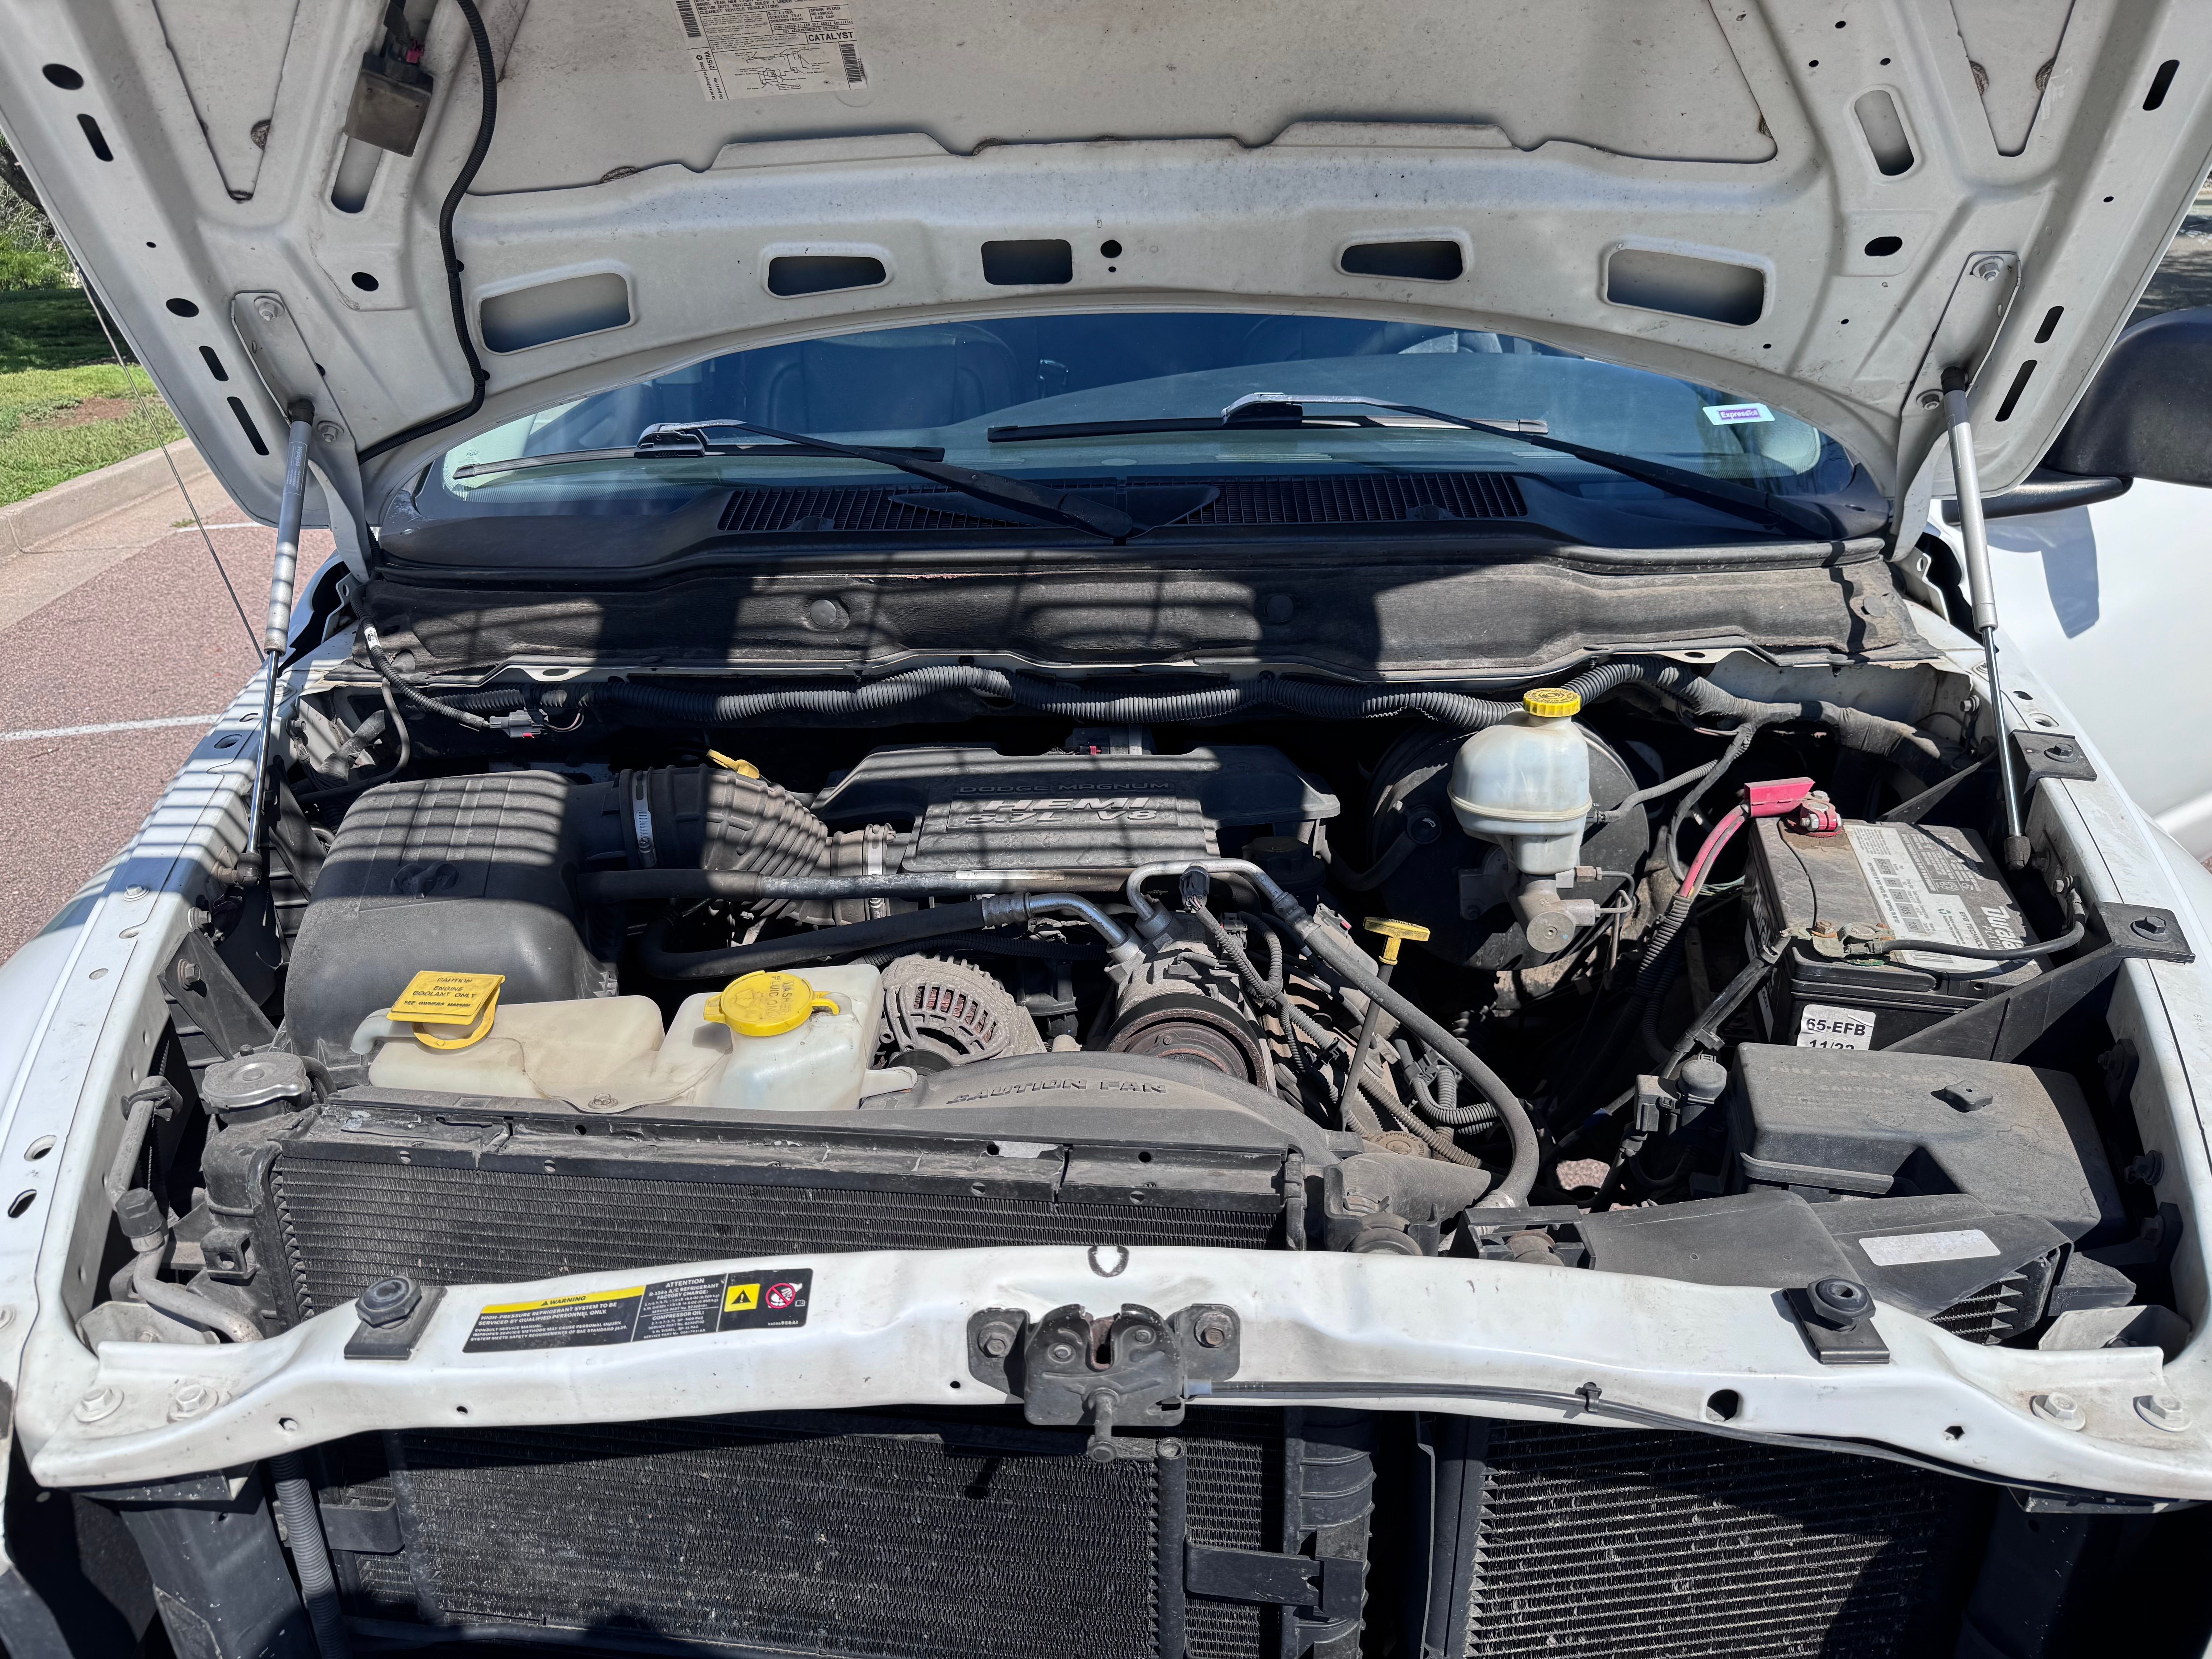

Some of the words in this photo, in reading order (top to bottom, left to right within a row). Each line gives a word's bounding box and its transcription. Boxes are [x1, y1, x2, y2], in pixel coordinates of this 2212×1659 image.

[808, 31, 853, 42] CATALYST
[1058, 783, 1169, 791] MAGNUM
[983, 797, 1150, 813] HEMI
[965, 812, 1063, 824] 5.7L
[1097, 810, 1157, 822] V8
[1893, 891, 1903, 900] 750
[1899, 906, 1911, 915] 935
[1959, 911, 1970, 922] EFB
[1907, 922, 1919, 930] 130
[1968, 923, 1984, 949] TECHNOL
[769, 975, 782, 997] FLUID
[780, 980, 795, 1015] WASHER
[766, 1000, 780, 1019] ONLY
[1806, 1018, 1866, 1036] 65-EFB
[946, 1079, 1087, 1104] CAUTION
[1100, 1080, 1167, 1094] FAN
[1386, 1132, 1419, 1142] APPROVED
[665, 1278, 705, 1288] ATTENTION
[680, 1283, 719, 1292] REFRIGERANT
[550, 1296, 586, 1305] WARNING
[532, 1307, 573, 1316] REFRIGERANT
[652, 1312, 692, 1321] COMPRESSOR
